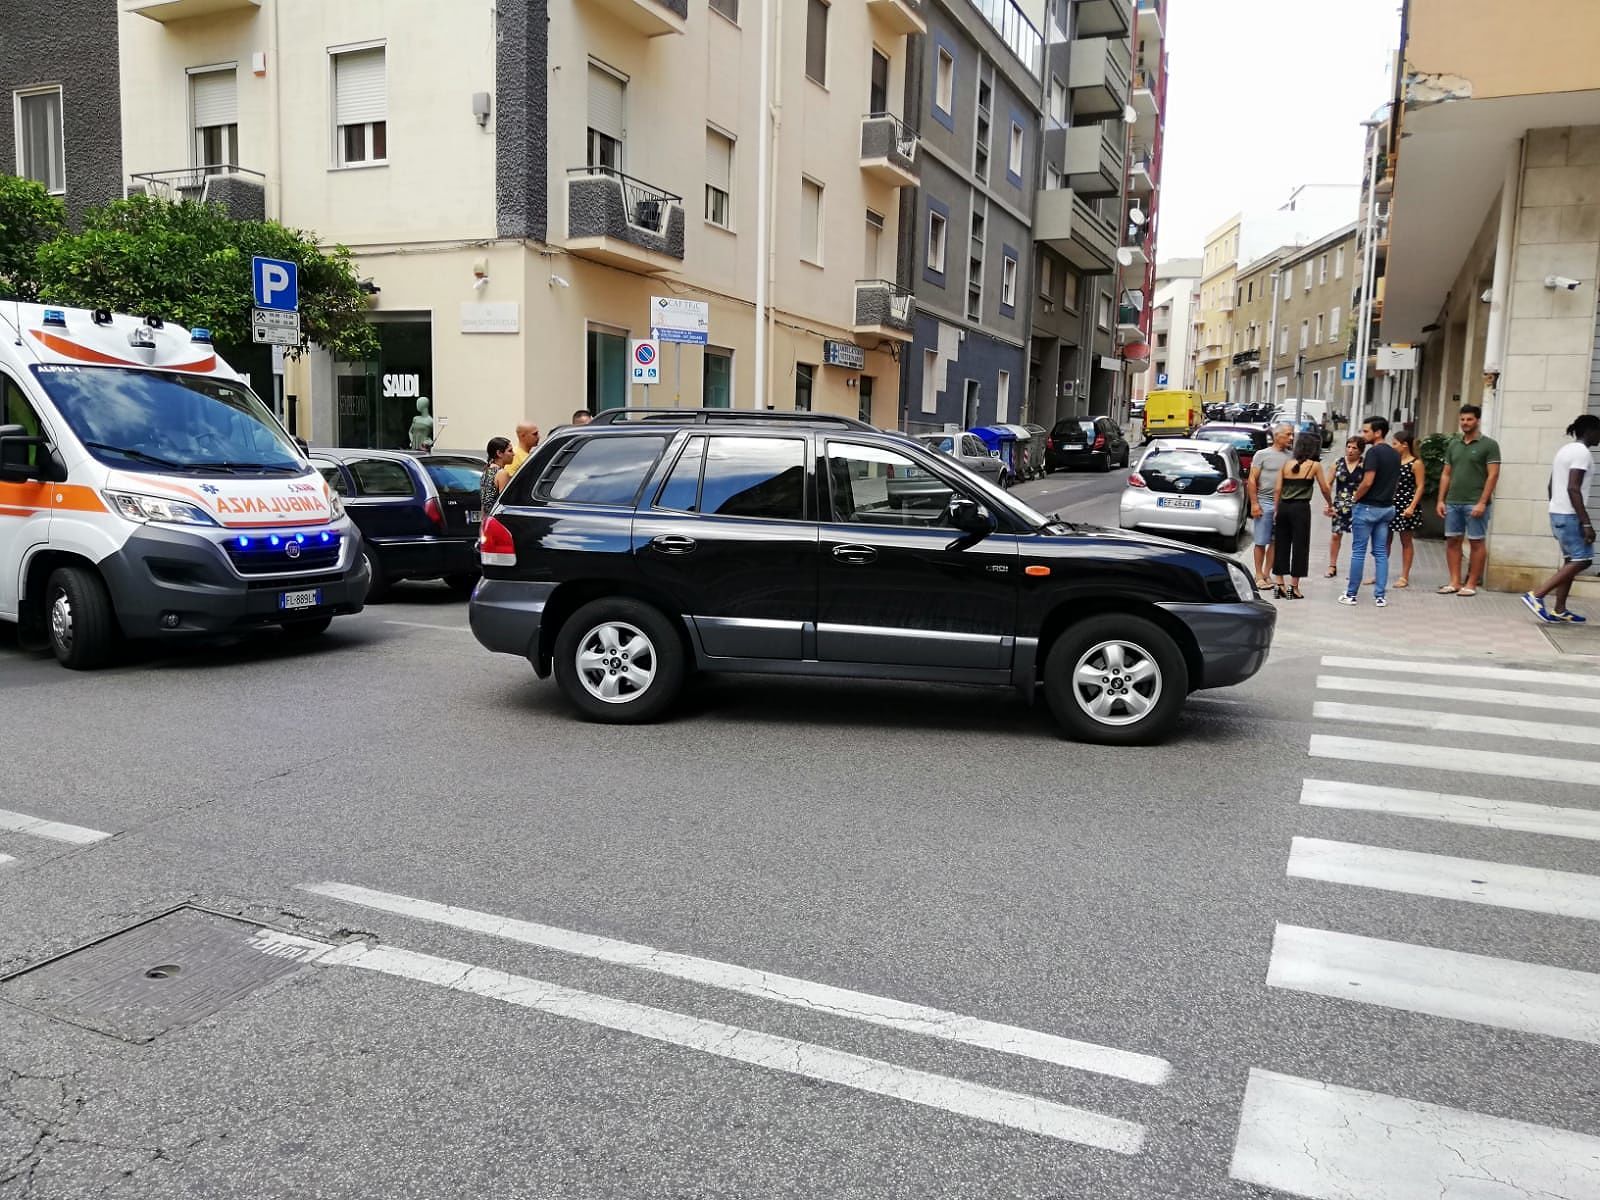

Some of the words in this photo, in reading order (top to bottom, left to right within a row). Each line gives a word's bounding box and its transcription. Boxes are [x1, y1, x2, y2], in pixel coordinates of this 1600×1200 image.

[262, 263, 289, 304] P
[383, 374, 419, 397] SALDI
[1158, 374, 1167, 384] P
